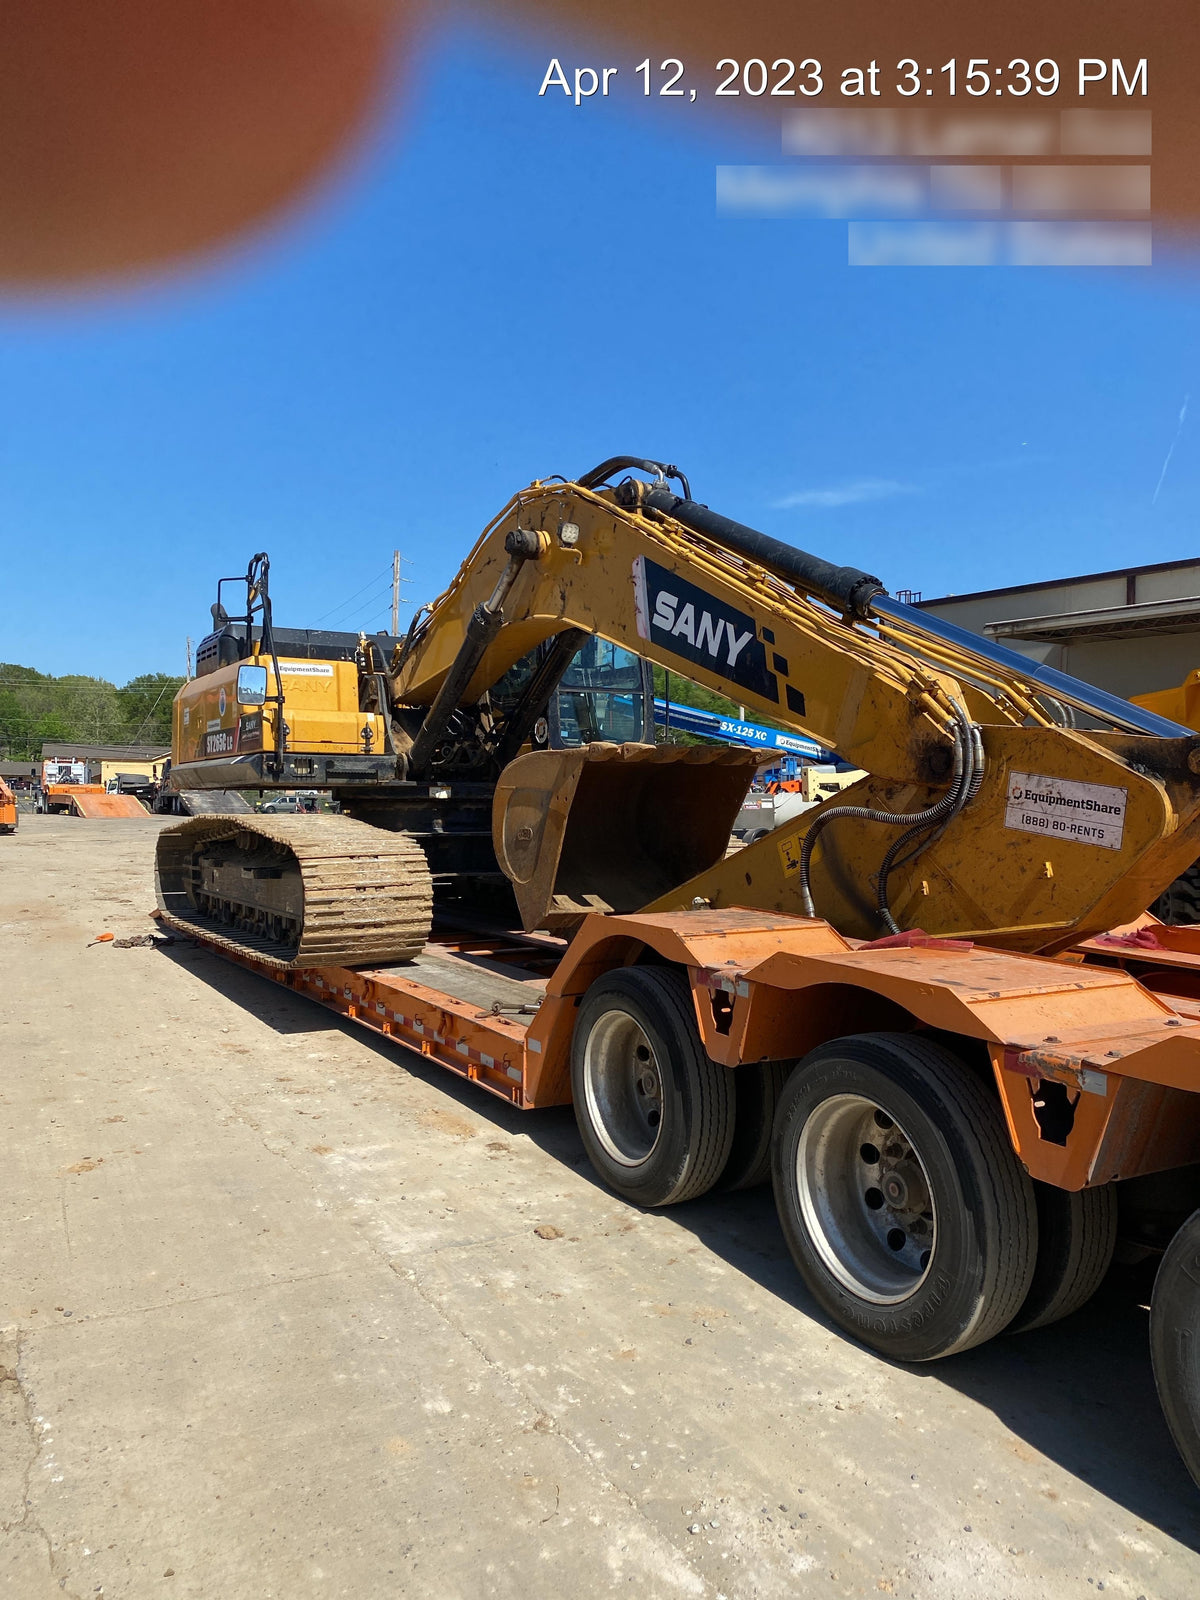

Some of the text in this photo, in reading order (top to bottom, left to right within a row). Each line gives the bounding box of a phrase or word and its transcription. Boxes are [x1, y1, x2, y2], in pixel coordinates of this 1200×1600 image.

[652, 591, 753, 667] SANY
[280, 665, 330, 674] EquipmentShare
[720, 722, 767, 741] SX-125 XC
[1024, 789, 1121, 815] EquipmentShare
[1021, 814, 1105, 839] (888) 80-RENTS
